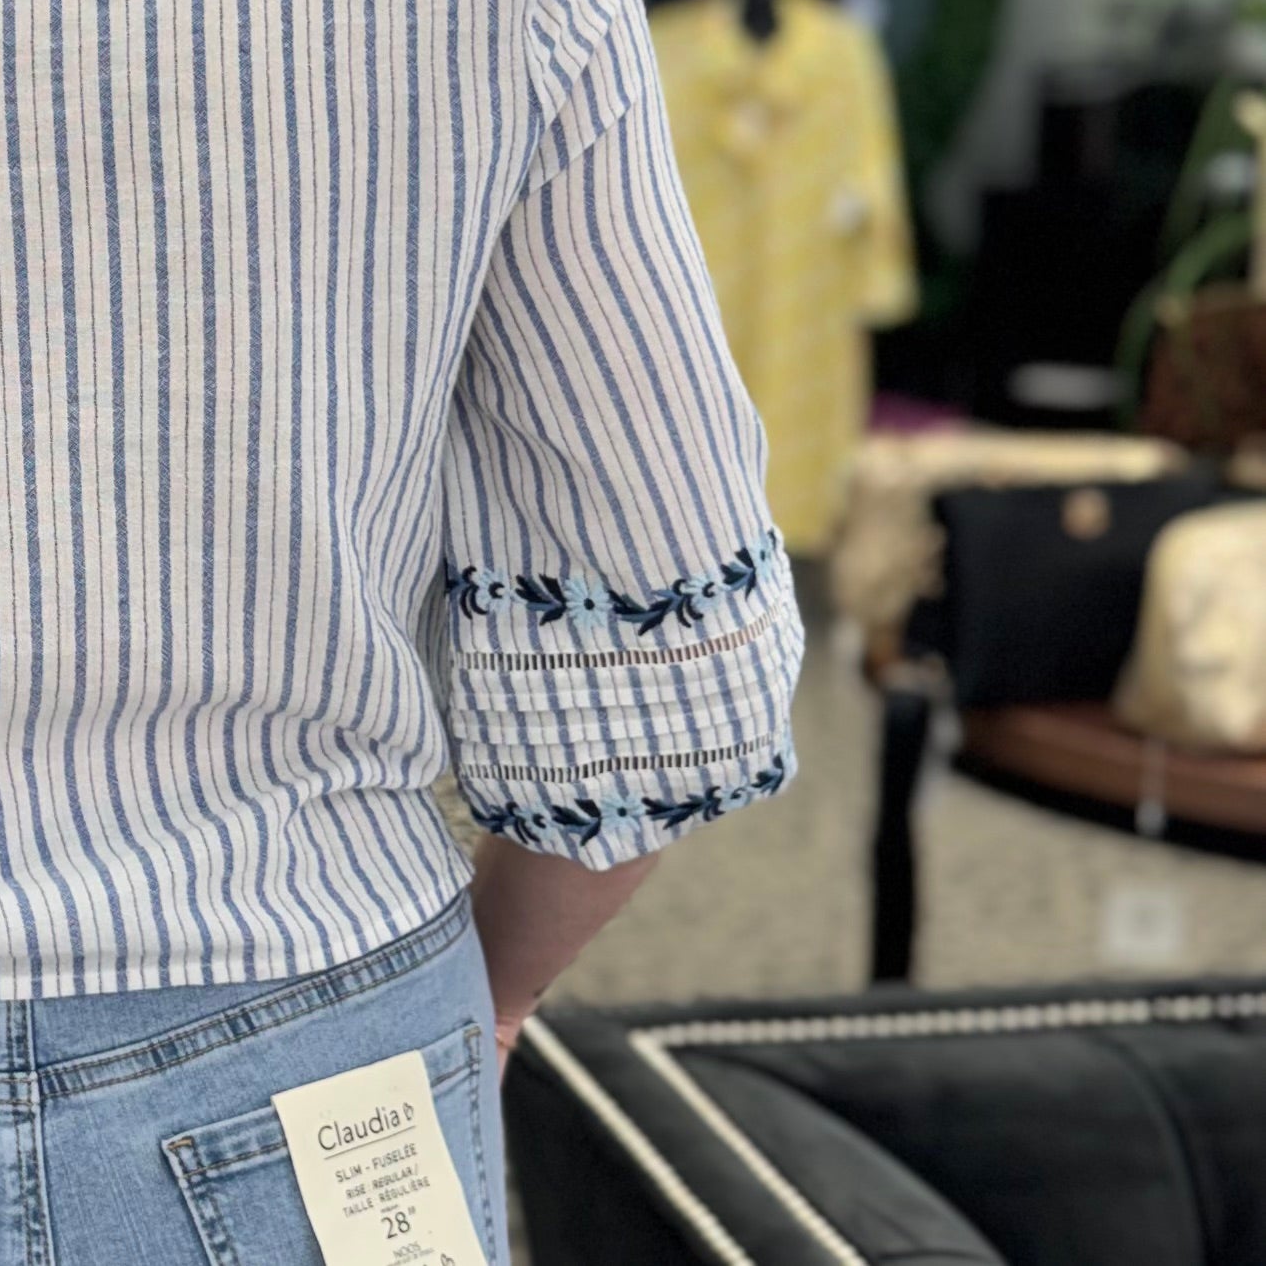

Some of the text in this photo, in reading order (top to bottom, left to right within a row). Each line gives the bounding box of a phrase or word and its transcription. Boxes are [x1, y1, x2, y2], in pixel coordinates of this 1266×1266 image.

[318, 1106, 400, 1151] Claudia
[335, 1164, 362, 1184] SLIM
[343, 1197, 374, 1218] TAILLE
